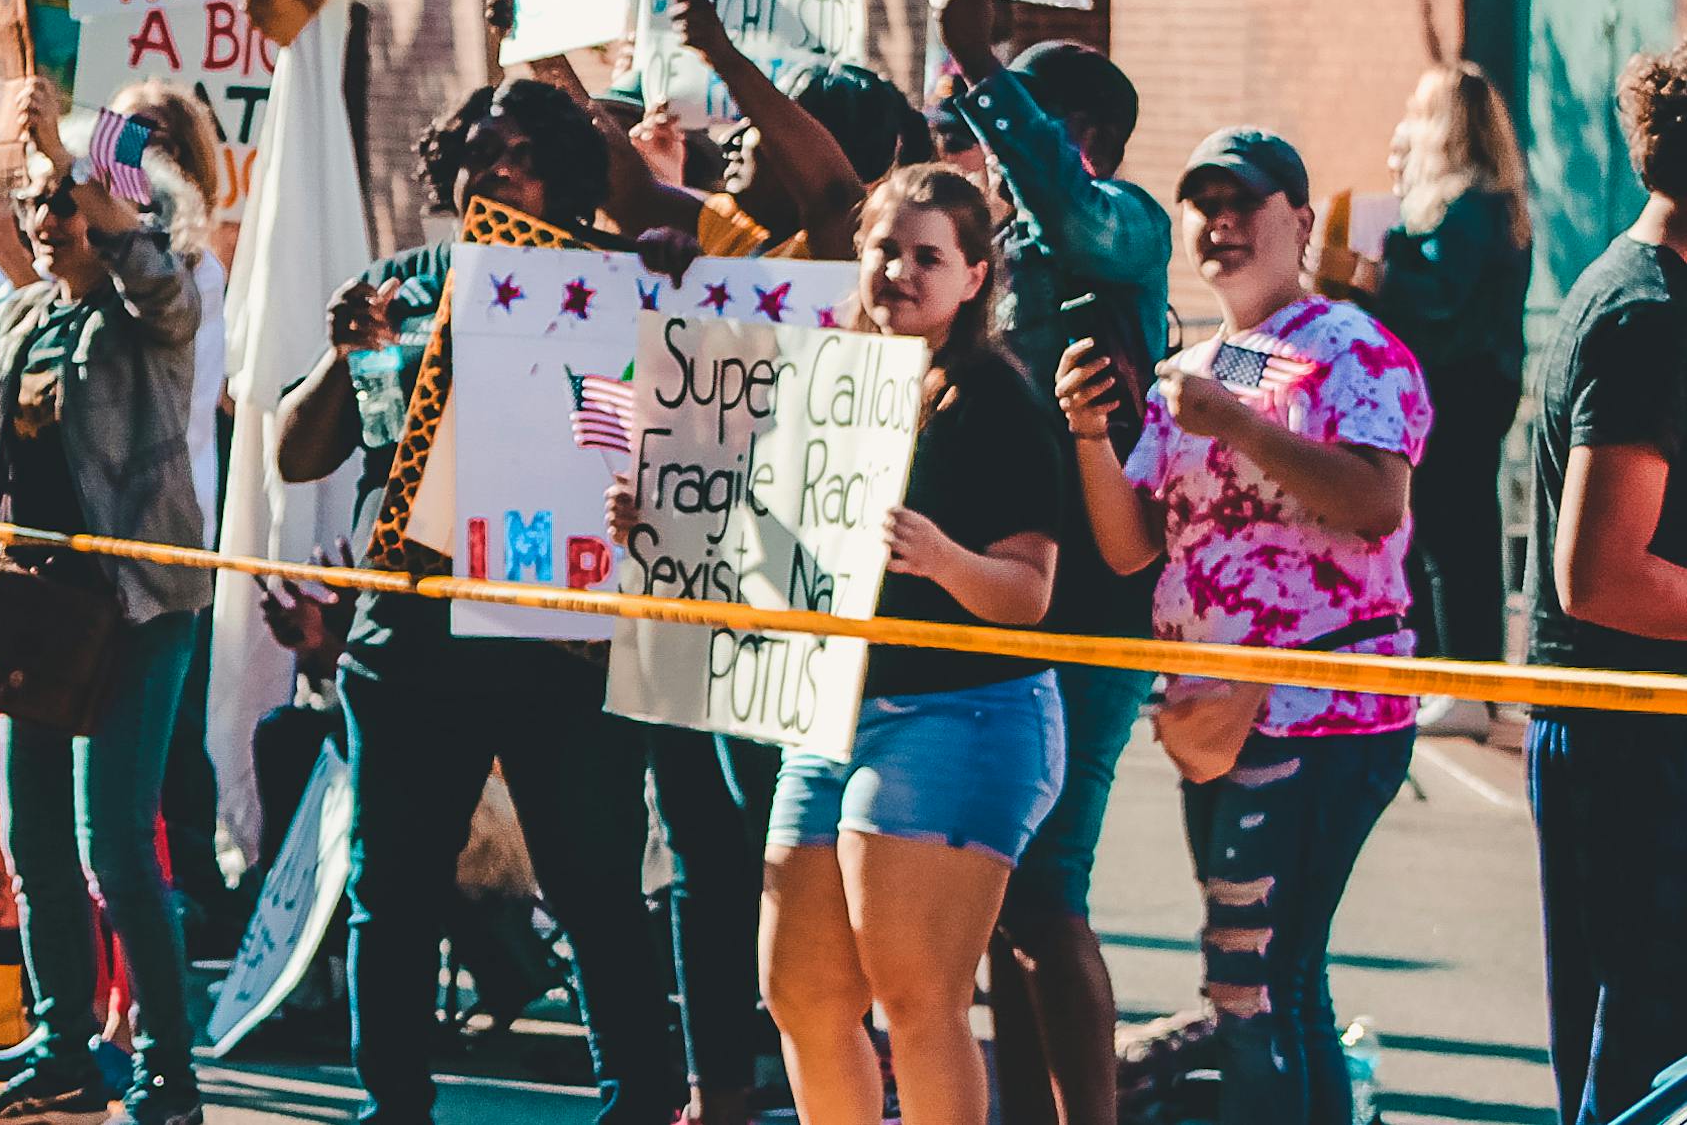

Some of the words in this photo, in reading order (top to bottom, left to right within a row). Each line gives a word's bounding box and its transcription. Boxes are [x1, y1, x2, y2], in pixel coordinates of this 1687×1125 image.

[128, 9, 182, 71] A
[655, 317, 797, 444] Super
[634, 428, 776, 544] Fragile
[466, 509, 612, 590] IMP
[706, 628, 827, 733] POTUS
